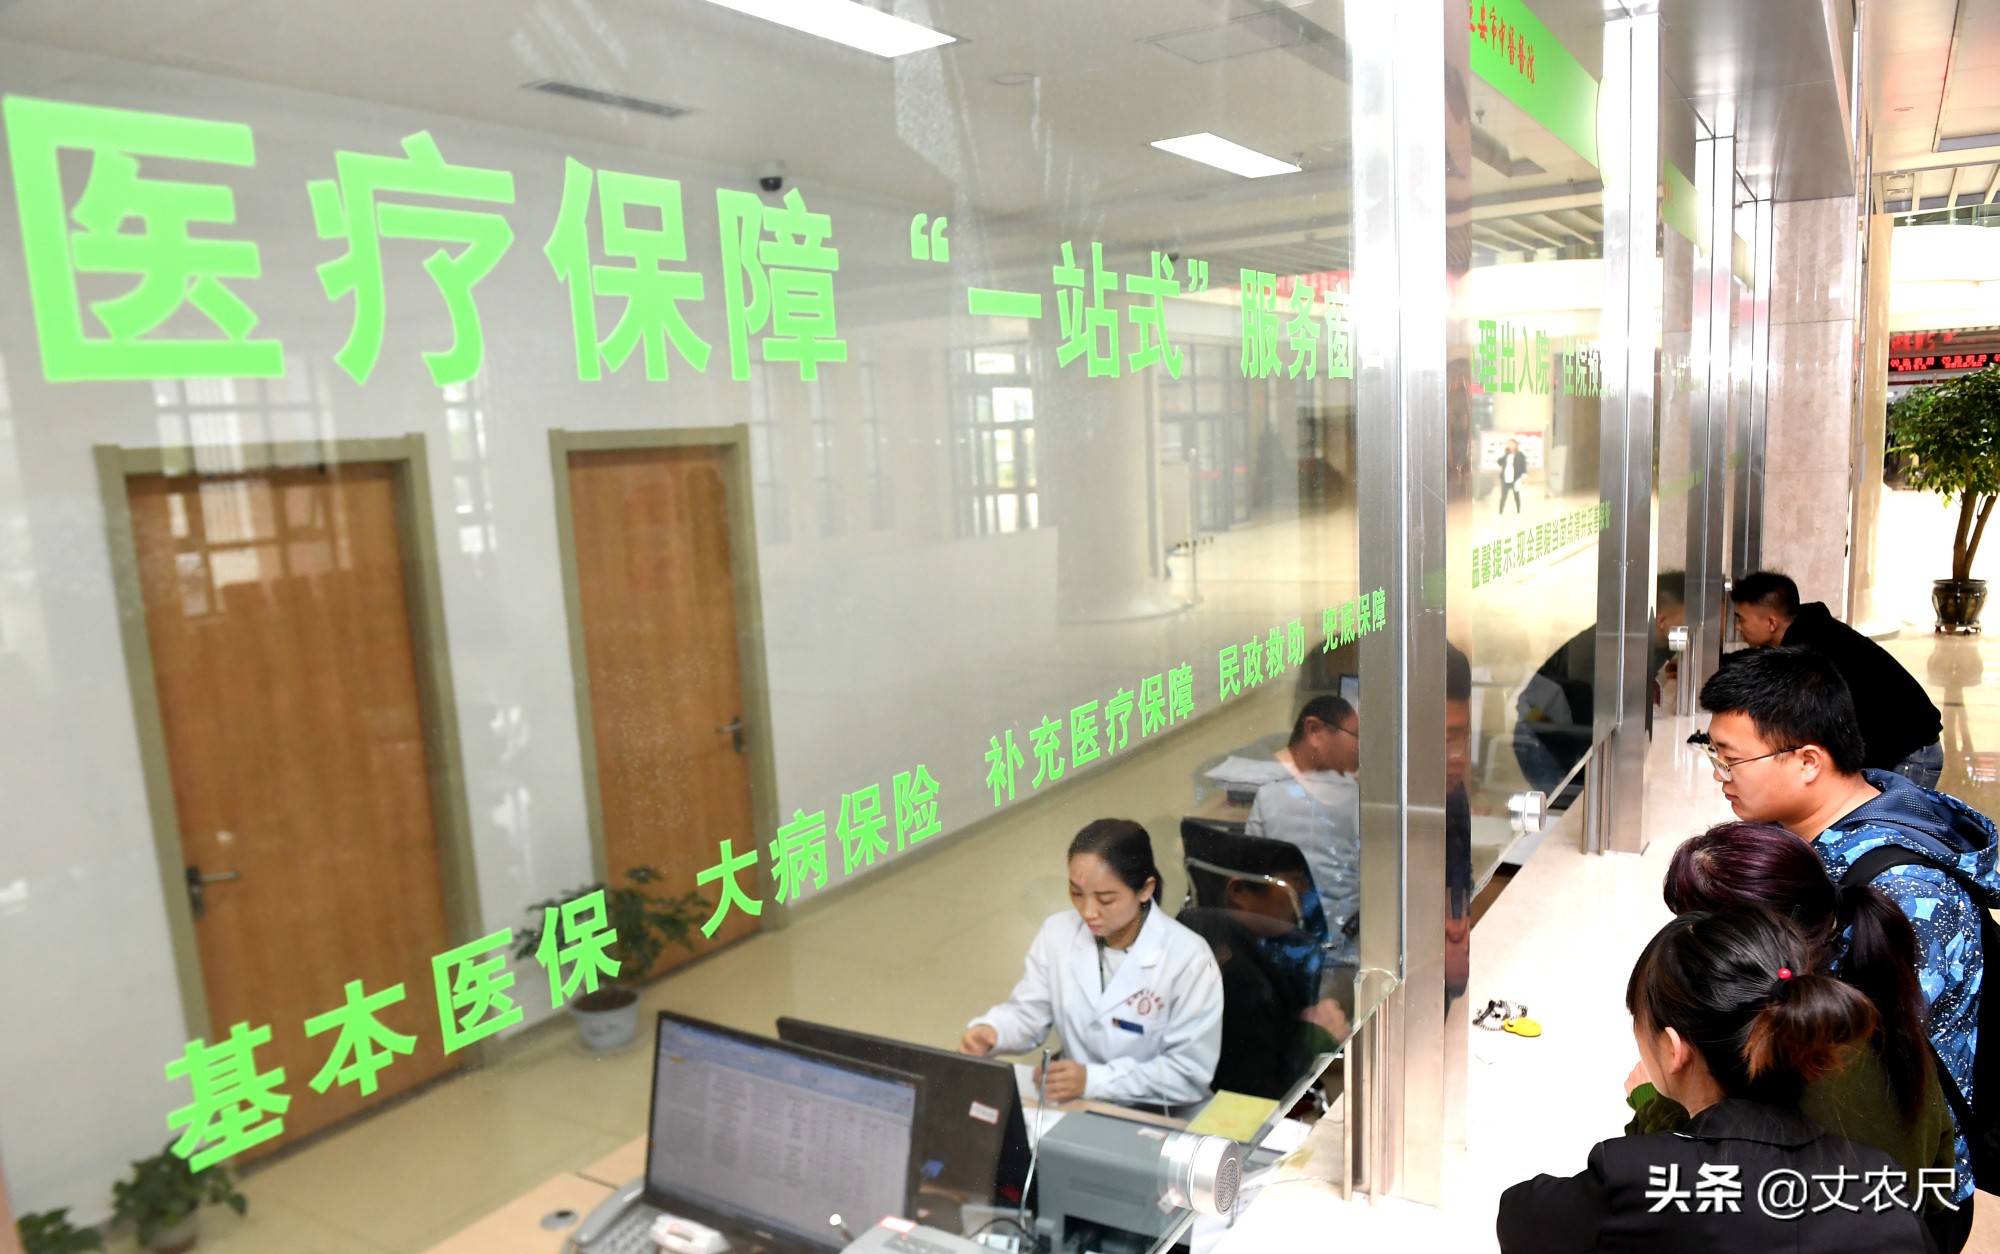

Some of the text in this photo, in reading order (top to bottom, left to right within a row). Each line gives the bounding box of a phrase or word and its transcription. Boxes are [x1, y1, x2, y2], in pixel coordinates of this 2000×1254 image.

[1471, 319, 1550, 395] 理出入院
[165, 890, 622, 1173] 基本医保
[696, 764, 943, 938] 大病保险
[984, 661, 1195, 807] 补充医疗保障
[1218, 618, 1306, 702] 民政救助
[1322, 586, 1387, 655] 兜底保障
